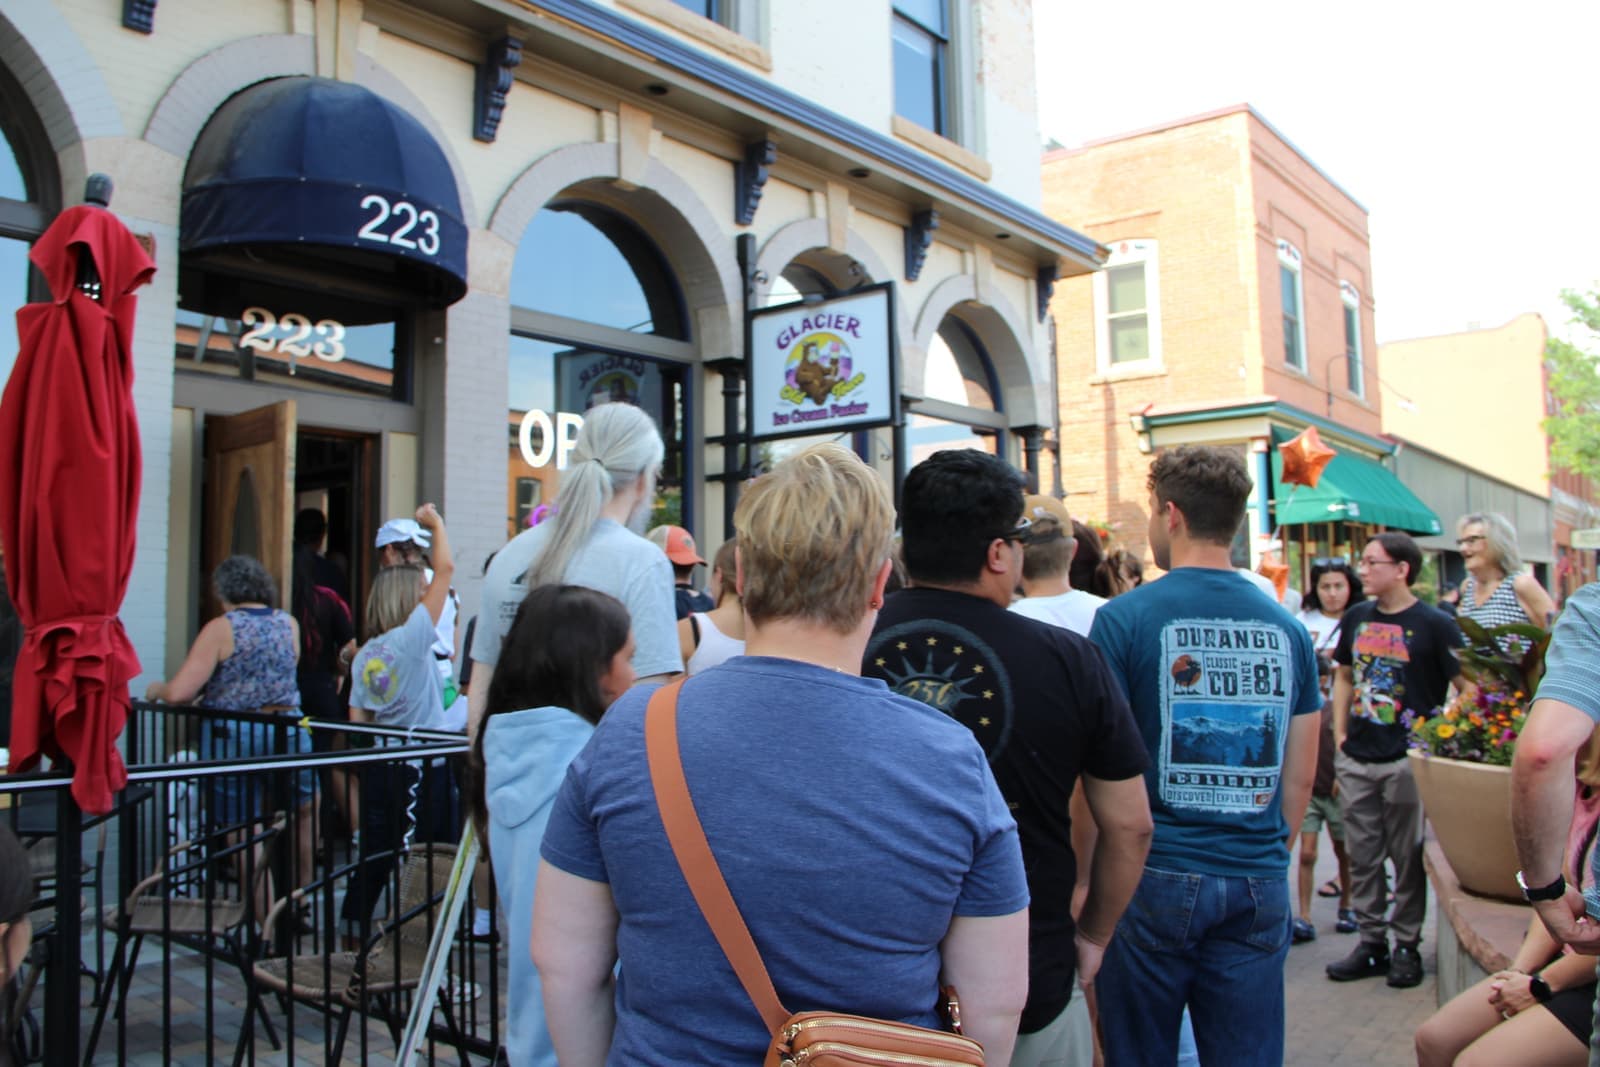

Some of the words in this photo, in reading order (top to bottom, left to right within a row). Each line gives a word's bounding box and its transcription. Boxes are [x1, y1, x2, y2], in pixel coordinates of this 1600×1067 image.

[358, 195, 440, 255] 223
[240, 308, 346, 362] 223
[776, 313, 861, 350] GLACIER
[1175, 627, 1279, 650] DURANGO
[1206, 656, 1238, 669] CLASSIC
[1241, 660, 1252, 695] SINCE
[1208, 670, 1238, 696] CO
[1253, 663, 1285, 697] 81
[1167, 790, 1211, 803] DISCOVER
